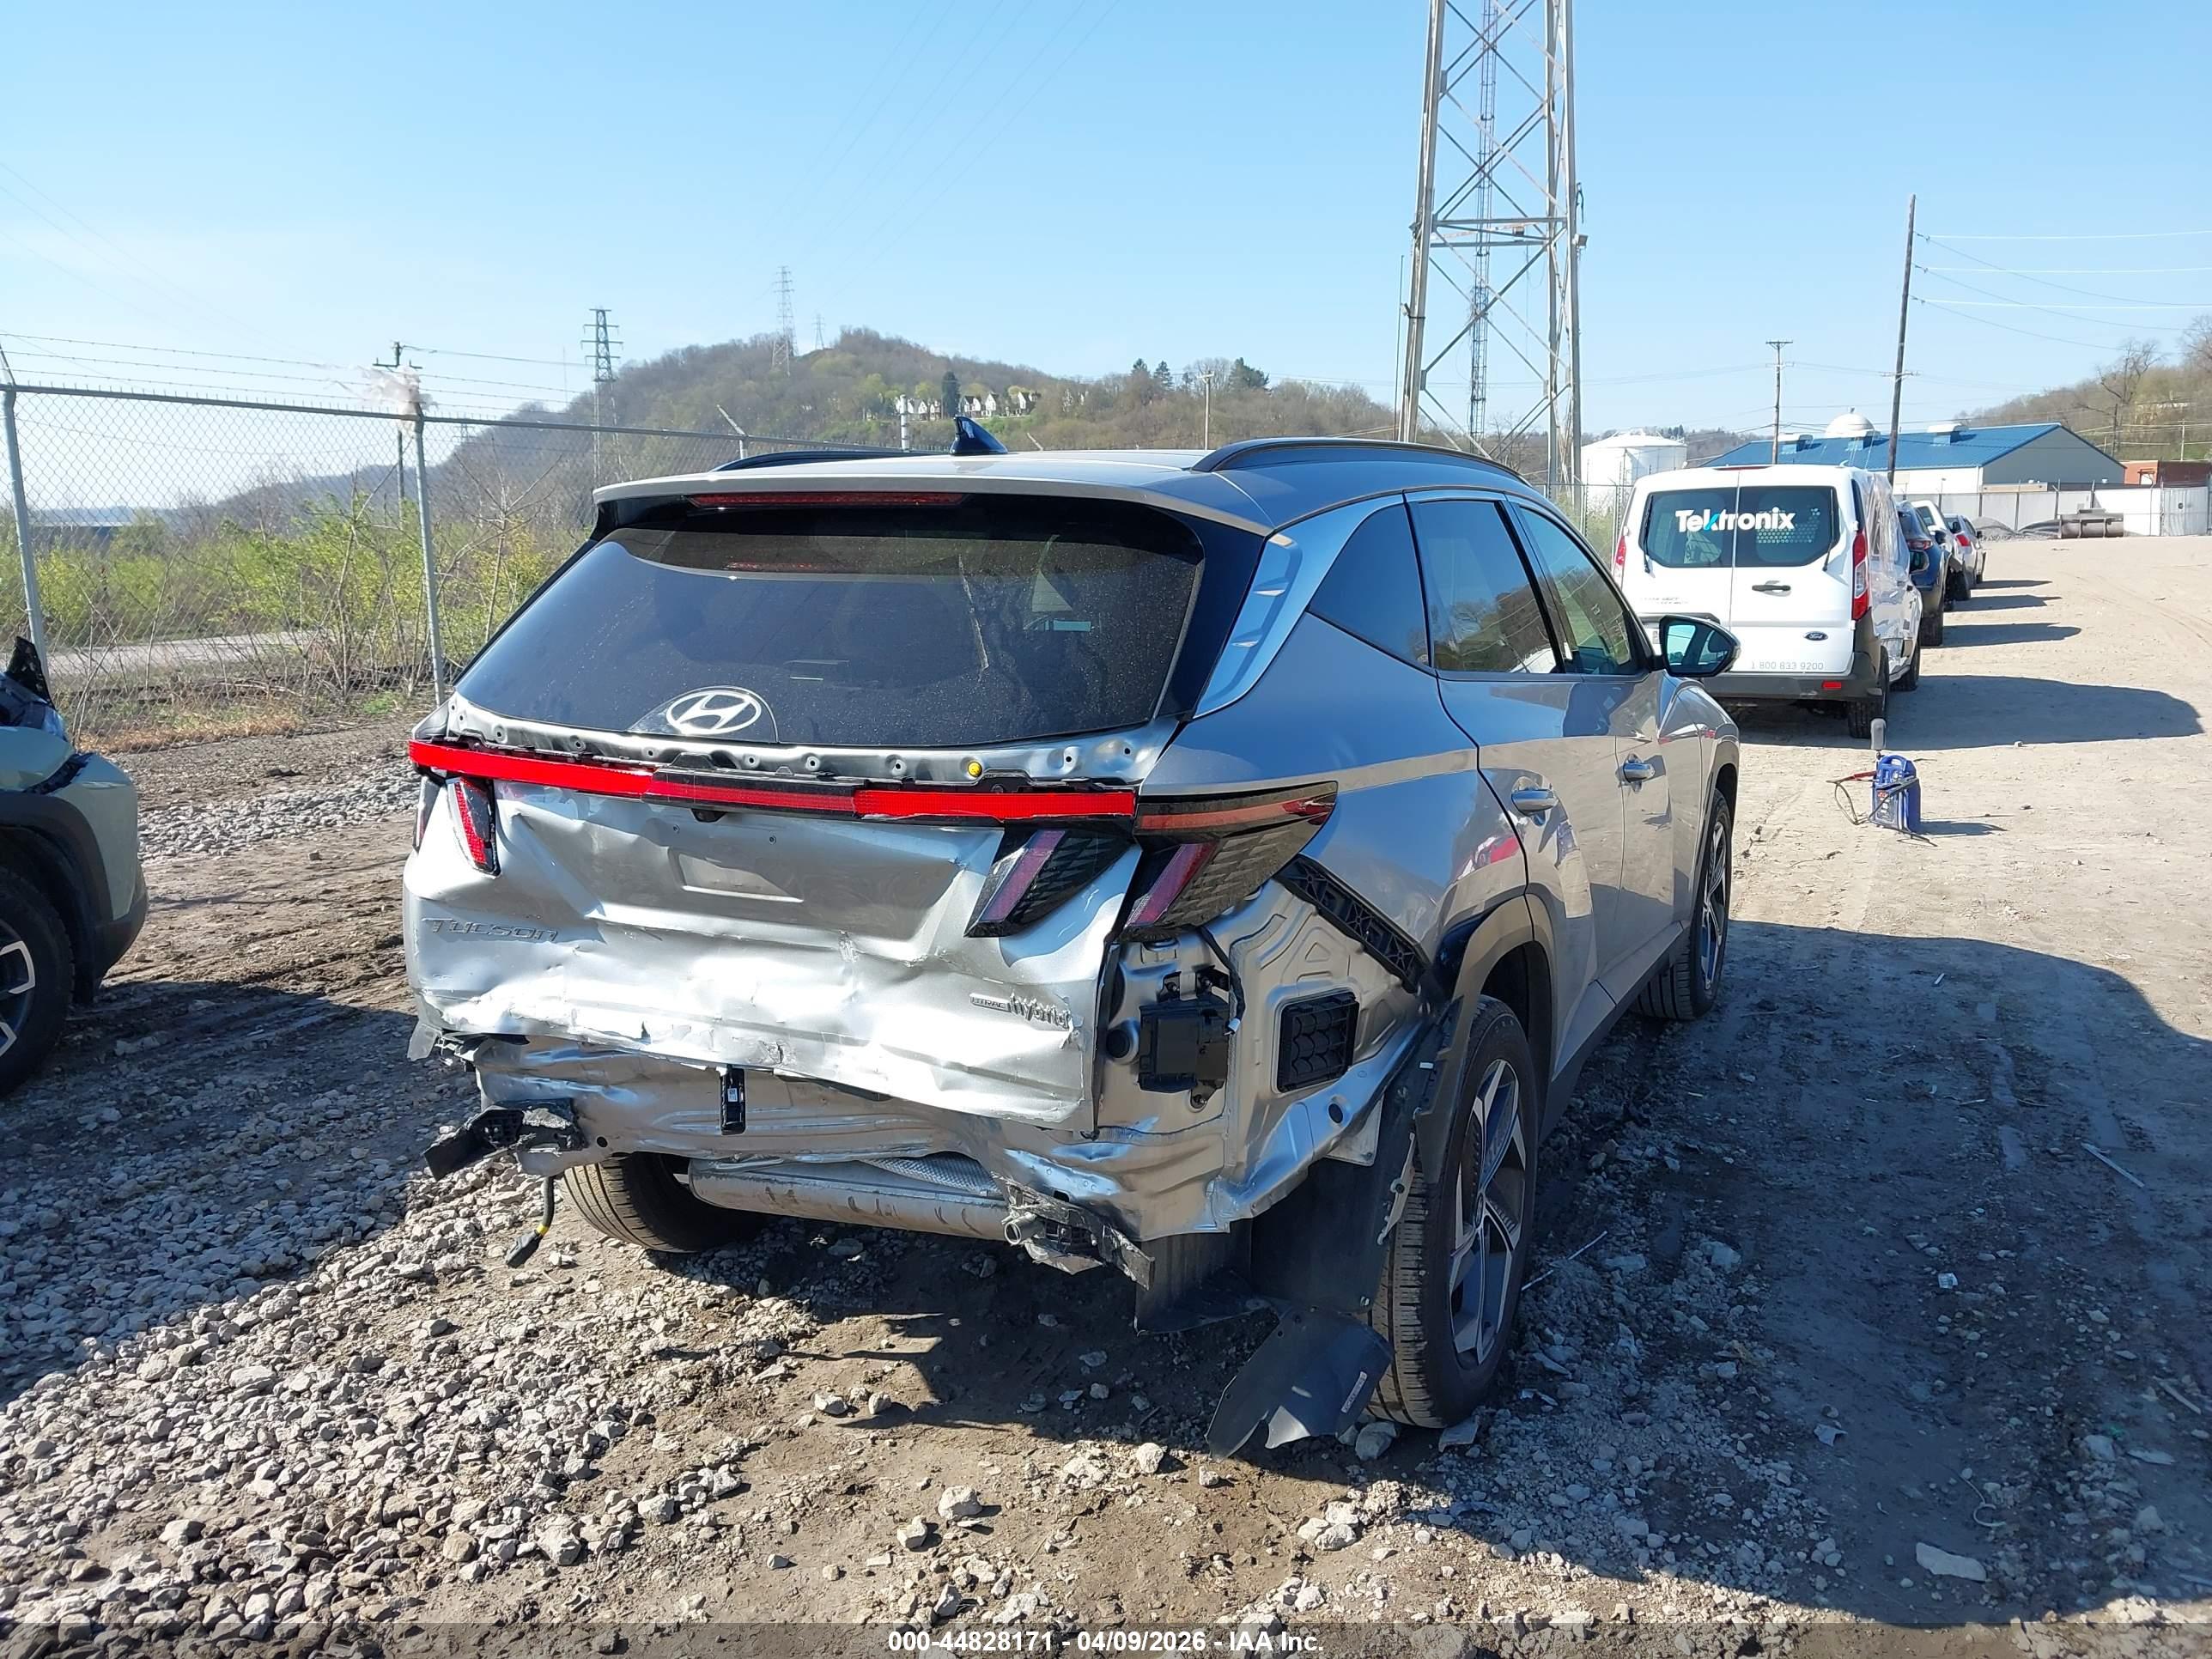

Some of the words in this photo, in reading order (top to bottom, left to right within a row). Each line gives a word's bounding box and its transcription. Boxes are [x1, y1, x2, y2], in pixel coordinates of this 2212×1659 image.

[1675, 507, 1796, 532] Tektronix
[1759, 661, 1777, 670] 800
[1779, 661, 1797, 670] 833
[1800, 662, 1824, 671] 9200
